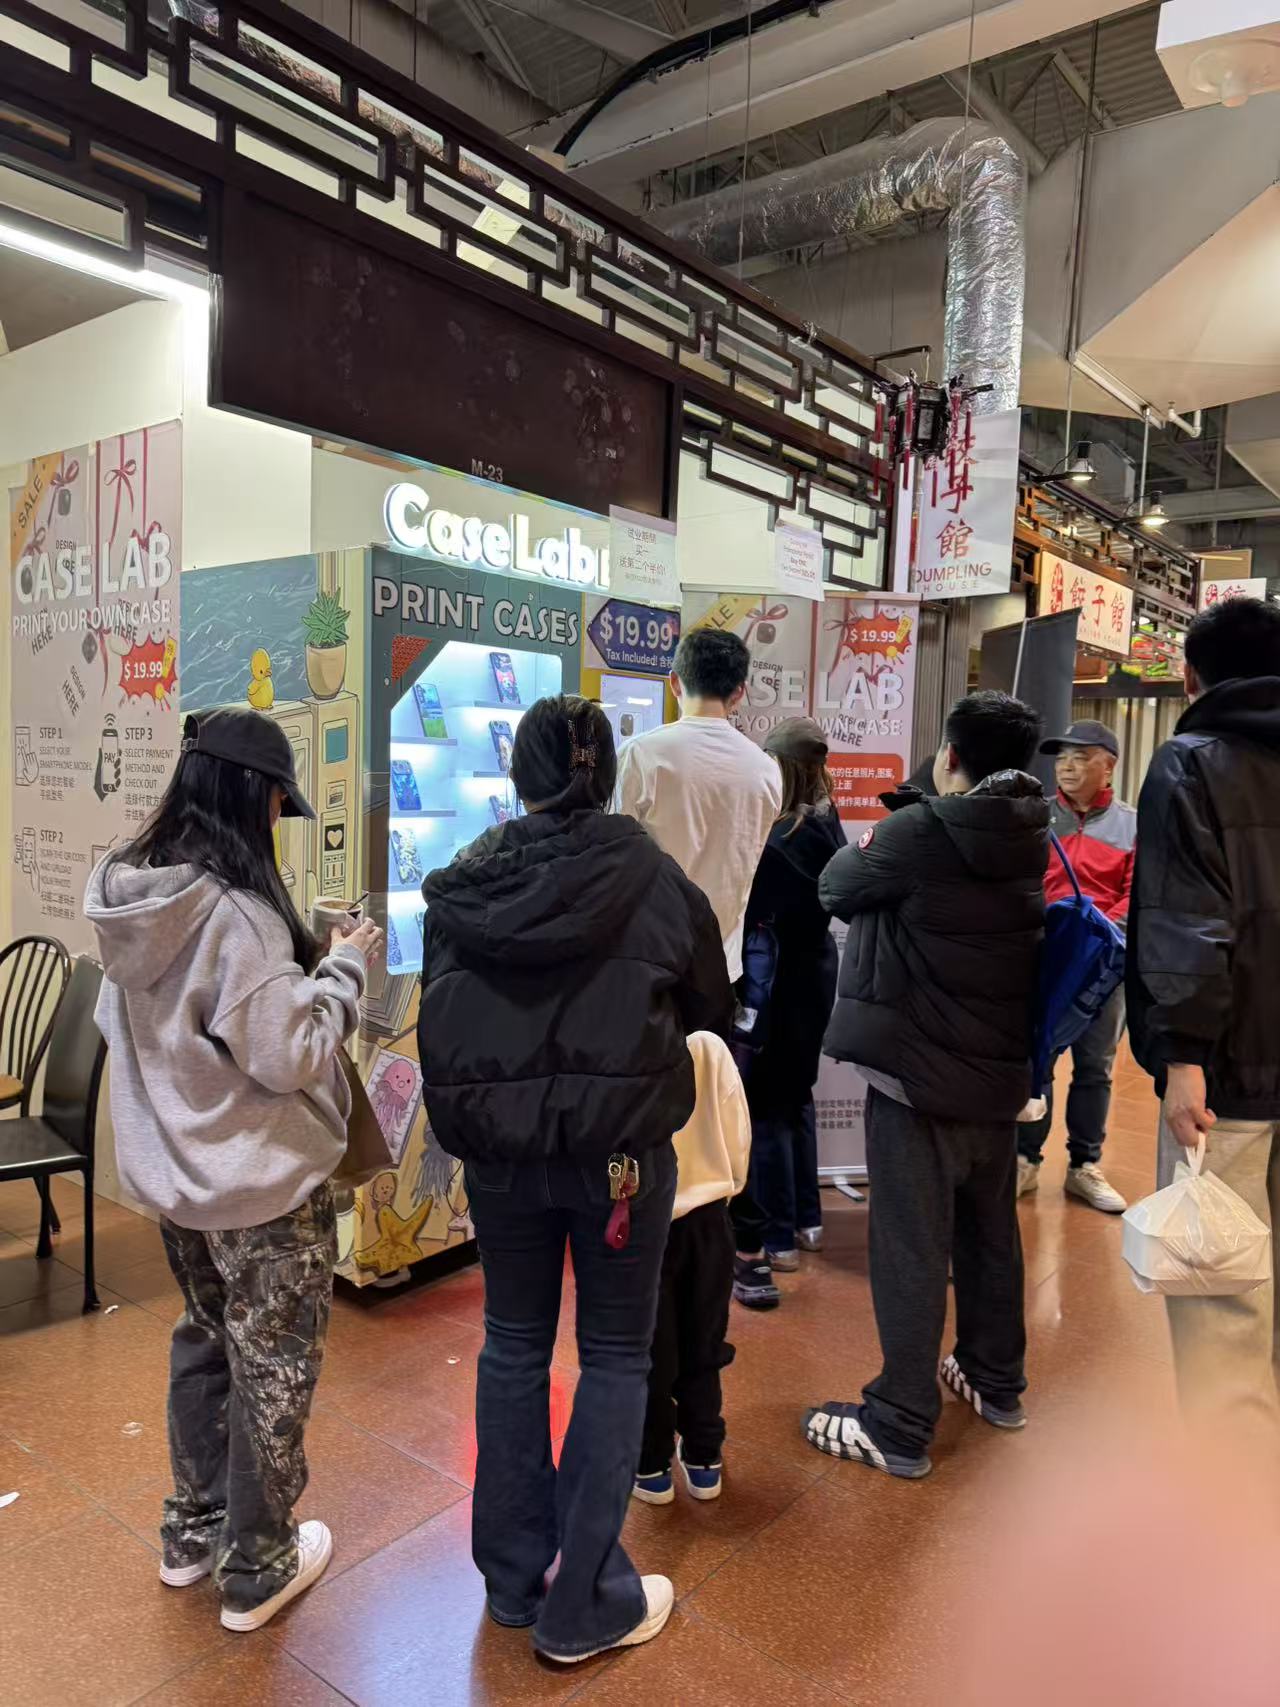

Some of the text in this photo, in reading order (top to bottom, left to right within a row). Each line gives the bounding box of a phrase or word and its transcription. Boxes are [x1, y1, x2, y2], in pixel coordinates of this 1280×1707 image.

[471, 459, 503, 482] M-23
[18, 474, 42, 529] SALE
[56, 539, 77, 551] DESIGN
[15, 532, 173, 604] CASE LAB
[924, 580, 977, 593] HOUSE
[12, 612, 49, 637] PRINT
[51, 608, 88, 633] YOUR
[89, 604, 128, 630] OWN
[130, 599, 171, 625] CASE
[372, 576, 579, 646] PRINT CASES
[599, 606, 673, 652] $19.99
[861, 630, 897, 643] 19.99
[605, 647, 620, 661] Tax
[622, 650, 658, 667] Included!
[133, 660, 163, 679] 19.99
[752, 660, 783, 673] DESIGN
[62, 679, 80, 717] HERE
[816, 670, 904, 711] LAB
[40, 727, 63, 739] STEP 1
[125, 727, 153, 740] STEP 3
[857, 718, 903, 736] CASE
[103, 752, 116, 764] PAY
[125, 748, 174, 759] SELECT PAYMENT
[125, 763, 165, 774] METHOD AND
[125, 779, 158, 789] CHECK OUT
[40, 829, 63, 844] STEP 2
[808, 1412, 880, 1452] AIR
